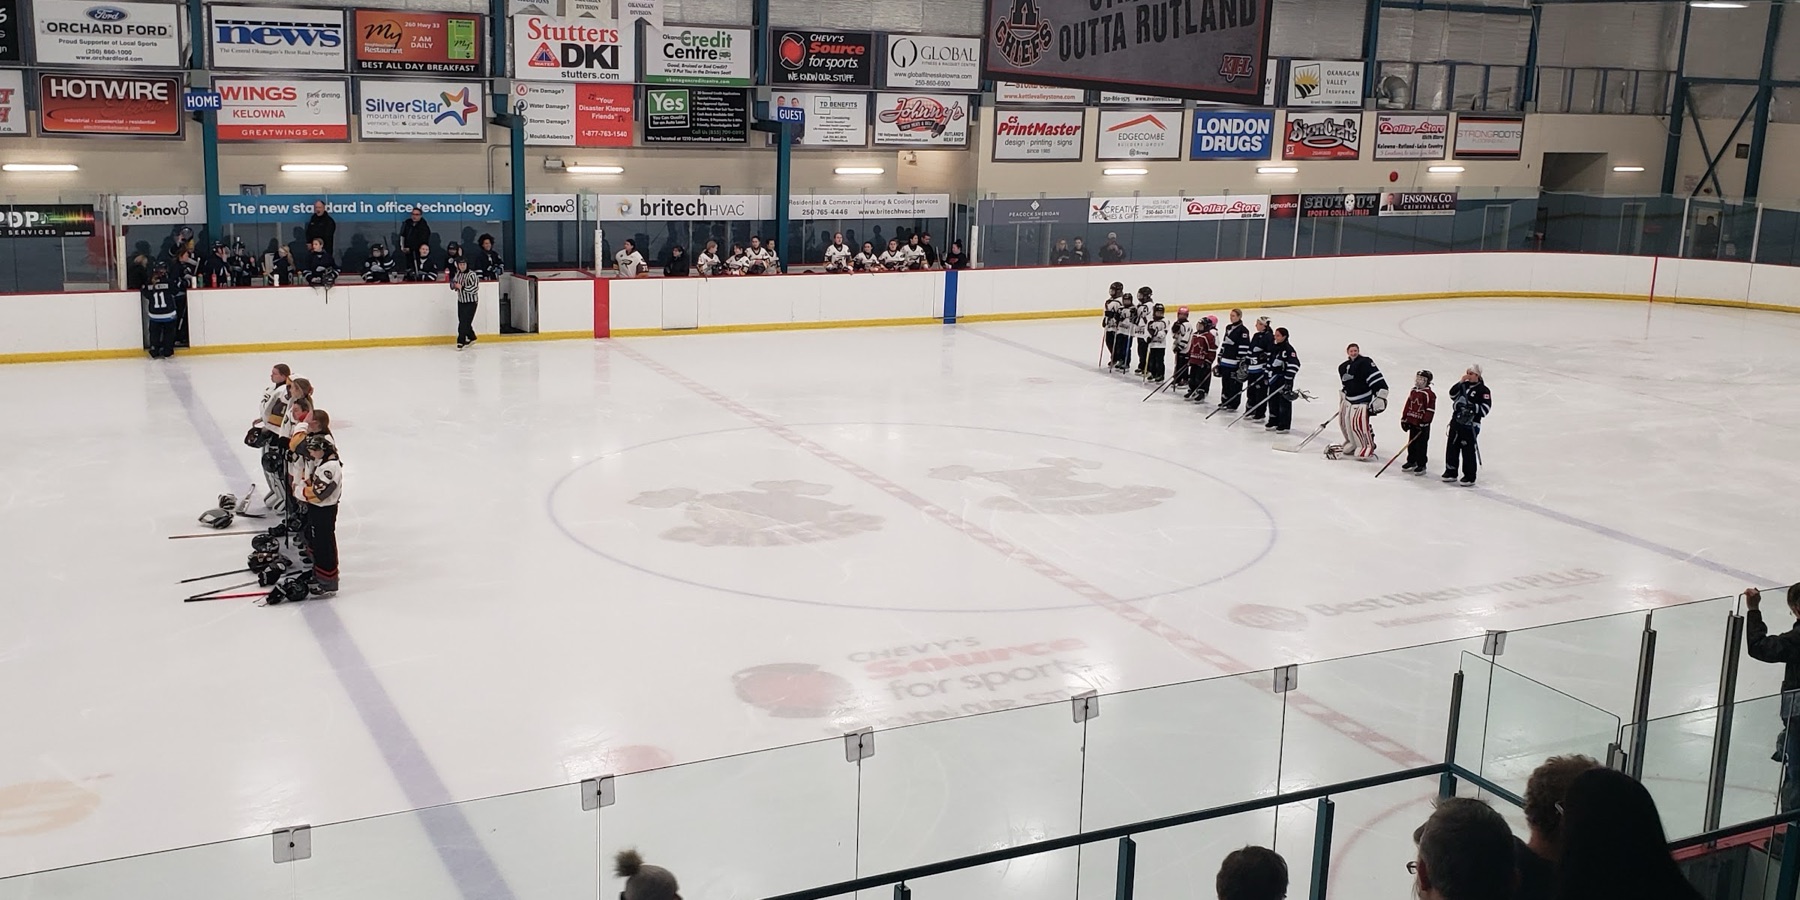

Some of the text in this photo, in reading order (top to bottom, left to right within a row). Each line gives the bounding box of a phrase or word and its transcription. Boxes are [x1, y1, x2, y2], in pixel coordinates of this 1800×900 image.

[94, 8, 120, 21] Ford
[46, 21, 168, 36] ORCHARD FORD
[228, 20, 327, 28] CAPITAL
[417, 22, 431, 30] Hwy
[527, 17, 619, 44] Stutters
[215, 25, 341, 48] news
[809, 33, 845, 43] CHEVY'S
[1058, 0, 1257, 63] OUTTA RUTLAND
[79, 39, 110, 47] Supporter
[137, 40, 157, 48] Sports
[410, 42, 434, 50] DAILY
[680, 30, 733, 49] Credit
[993, 16, 1055, 68] CHIEFS
[364, 47, 404, 55] Restaurant
[663, 42, 718, 61] Centre
[808, 42, 866, 56] Source
[920, 45, 978, 62] GLOBAL
[560, 43, 619, 70] DKI
[807, 54, 824, 68] for
[361, 61, 476, 73] BEST ALL DAY BREAKFAST
[561, 70, 620, 81] stutters.com
[787, 71, 800, 82] WE
[799, 72, 818, 82] KNOW
[817, 73, 834, 82] OUR
[50, 78, 168, 101] HOTWIRE
[218, 85, 298, 101] WINGS
[540, 87, 565, 96] Damage?
[187, 95, 220, 109] HOME
[650, 92, 685, 112] Yes
[1003, 93, 1077, 102] www.kettlevalleystone.com
[365, 98, 443, 114] SilverStar
[545, 103, 570, 112] Damage?
[578, 104, 631, 114] Disaster Kleenup
[829, 101, 858, 109] BENEFITS
[878, 97, 965, 126] Johnny's
[233, 109, 286, 119] KELOWNA
[407, 113, 435, 121] resort
[778, 108, 803, 121] GUEST
[1007, 115, 1019, 124] CS
[94, 118, 124, 126] commercial
[545, 119, 570, 127] Damage?
[1196, 117, 1271, 135] LONDON
[1379, 121, 1446, 135] Dollar Store
[241, 129, 326, 137] GREATWINGS.CA
[997, 122, 1082, 136] PrintMaster
[1289, 118, 1358, 148] SignCraft
[1457, 129, 1522, 139] STRONGROOTS
[1004, 138, 1074, 148] design printing signs
[1117, 132, 1165, 142] EDGECOMBE
[1200, 134, 1264, 154] DRUGS
[1427, 143, 1444, 152] Country
[536, 198, 575, 214] innov8
[821, 198, 828, 206] &
[828, 198, 863, 206] Commercial
[863, 198, 886, 207] Heating
[886, 198, 893, 206] &
[892, 197, 915, 207] Cooling
[915, 198, 939, 206] services
[1270, 201, 1298, 211] signcraft.ca
[1400, 193, 1433, 206] JENSON
[143, 199, 189, 217] innov8
[228, 200, 495, 217] The new stadard in office technology.
[640, 197, 745, 217] britech HVAC
[858, 207, 927, 217] www.britechhvac.com
[1103, 204, 1140, 215] CREATIVE
[1186, 201, 1228, 215] Dollar
[1226, 200, 1262, 215] Store
[1307, 209, 1330, 218] SPORTS
[152, 291, 168, 309] 11
[1281, 350, 1288, 359] C
[1469, 390, 1477, 398] C
[1308, 596, 1384, 618] Best
[1388, 578, 1512, 608] Western
[848, 636, 982, 663] CHEVY'S
[863, 637, 1091, 680] Source
[885, 677, 954, 701] for
